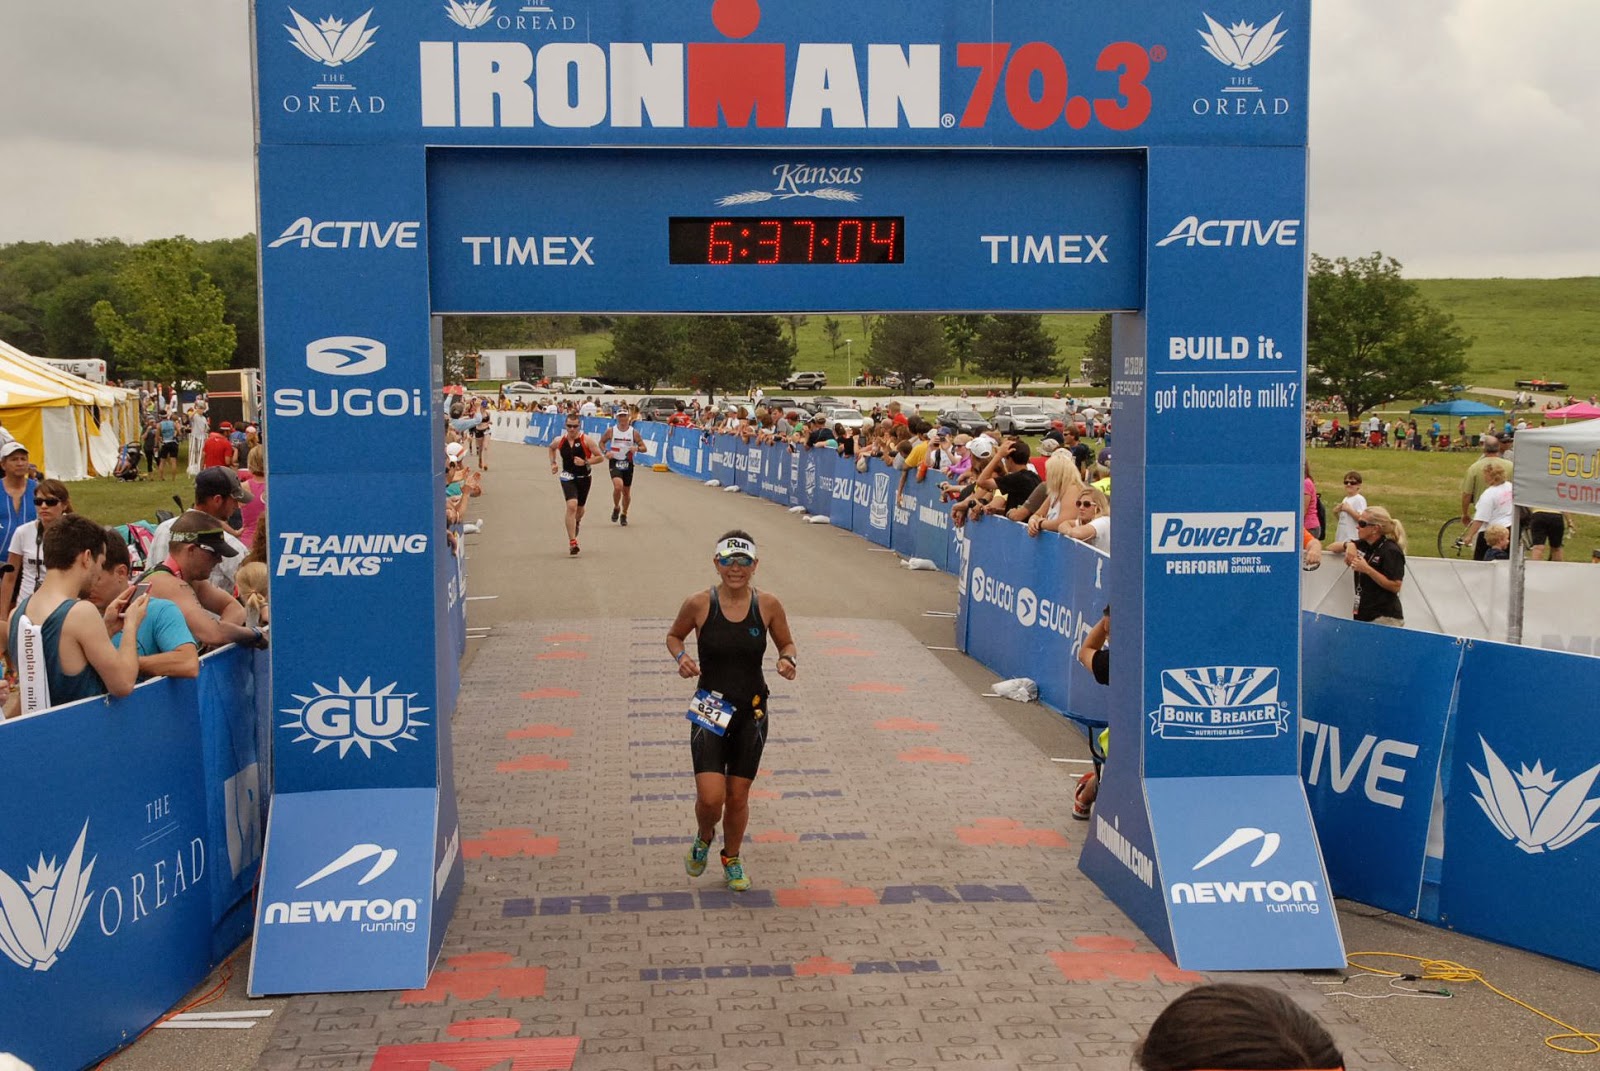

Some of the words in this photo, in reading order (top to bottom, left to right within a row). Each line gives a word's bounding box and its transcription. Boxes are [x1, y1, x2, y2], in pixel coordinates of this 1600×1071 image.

[496, 16, 576, 31] OREAD
[322, 74, 345, 82] THE
[419, 41, 941, 129] IRONMAN
[956, 41, 1153, 131] 70.3
[1230, 77, 1253, 85] THE
[283, 96, 386, 114] OREAD
[1193, 98, 1290, 116] OREAD
[773, 163, 864, 194] Kansas
[267, 216, 420, 249] ACTIVE
[1155, 215, 1301, 247] ACTIVE
[462, 236, 594, 266] TIMEX
[980, 235, 1109, 264] TIMEX
[1169, 337, 1249, 360] BUILD
[1257, 335, 1283, 360] it.
[273, 388, 421, 417] SUGOi
[1155, 386, 1178, 414] got
[1183, 383, 1252, 409] chocolate
[1257, 382, 1297, 408] milk?
[832, 477, 853, 501] 2XU
[854, 481, 871, 507] 2XU
[279, 532, 427, 554] TRAINING
[1158, 517, 1289, 548] PowerBar
[276, 555, 382, 576] PEAKS
[1166, 560, 1228, 574] PERFORM
[1231, 557, 1262, 566] SPORTS
[1231, 565, 1255, 574] DRINK
[1256, 565, 1271, 574] MIX
[24, 628, 36, 682] chocolate
[28, 687, 37, 710] milk
[305, 695, 409, 739] GU
[1164, 707, 1204, 723] BONK
[1210, 706, 1276, 723] BREAKER
[145, 794, 171, 824] THE
[100, 837, 205, 937] OREAD
[1266, 902, 1319, 915] running
[361, 920, 416, 933] running
